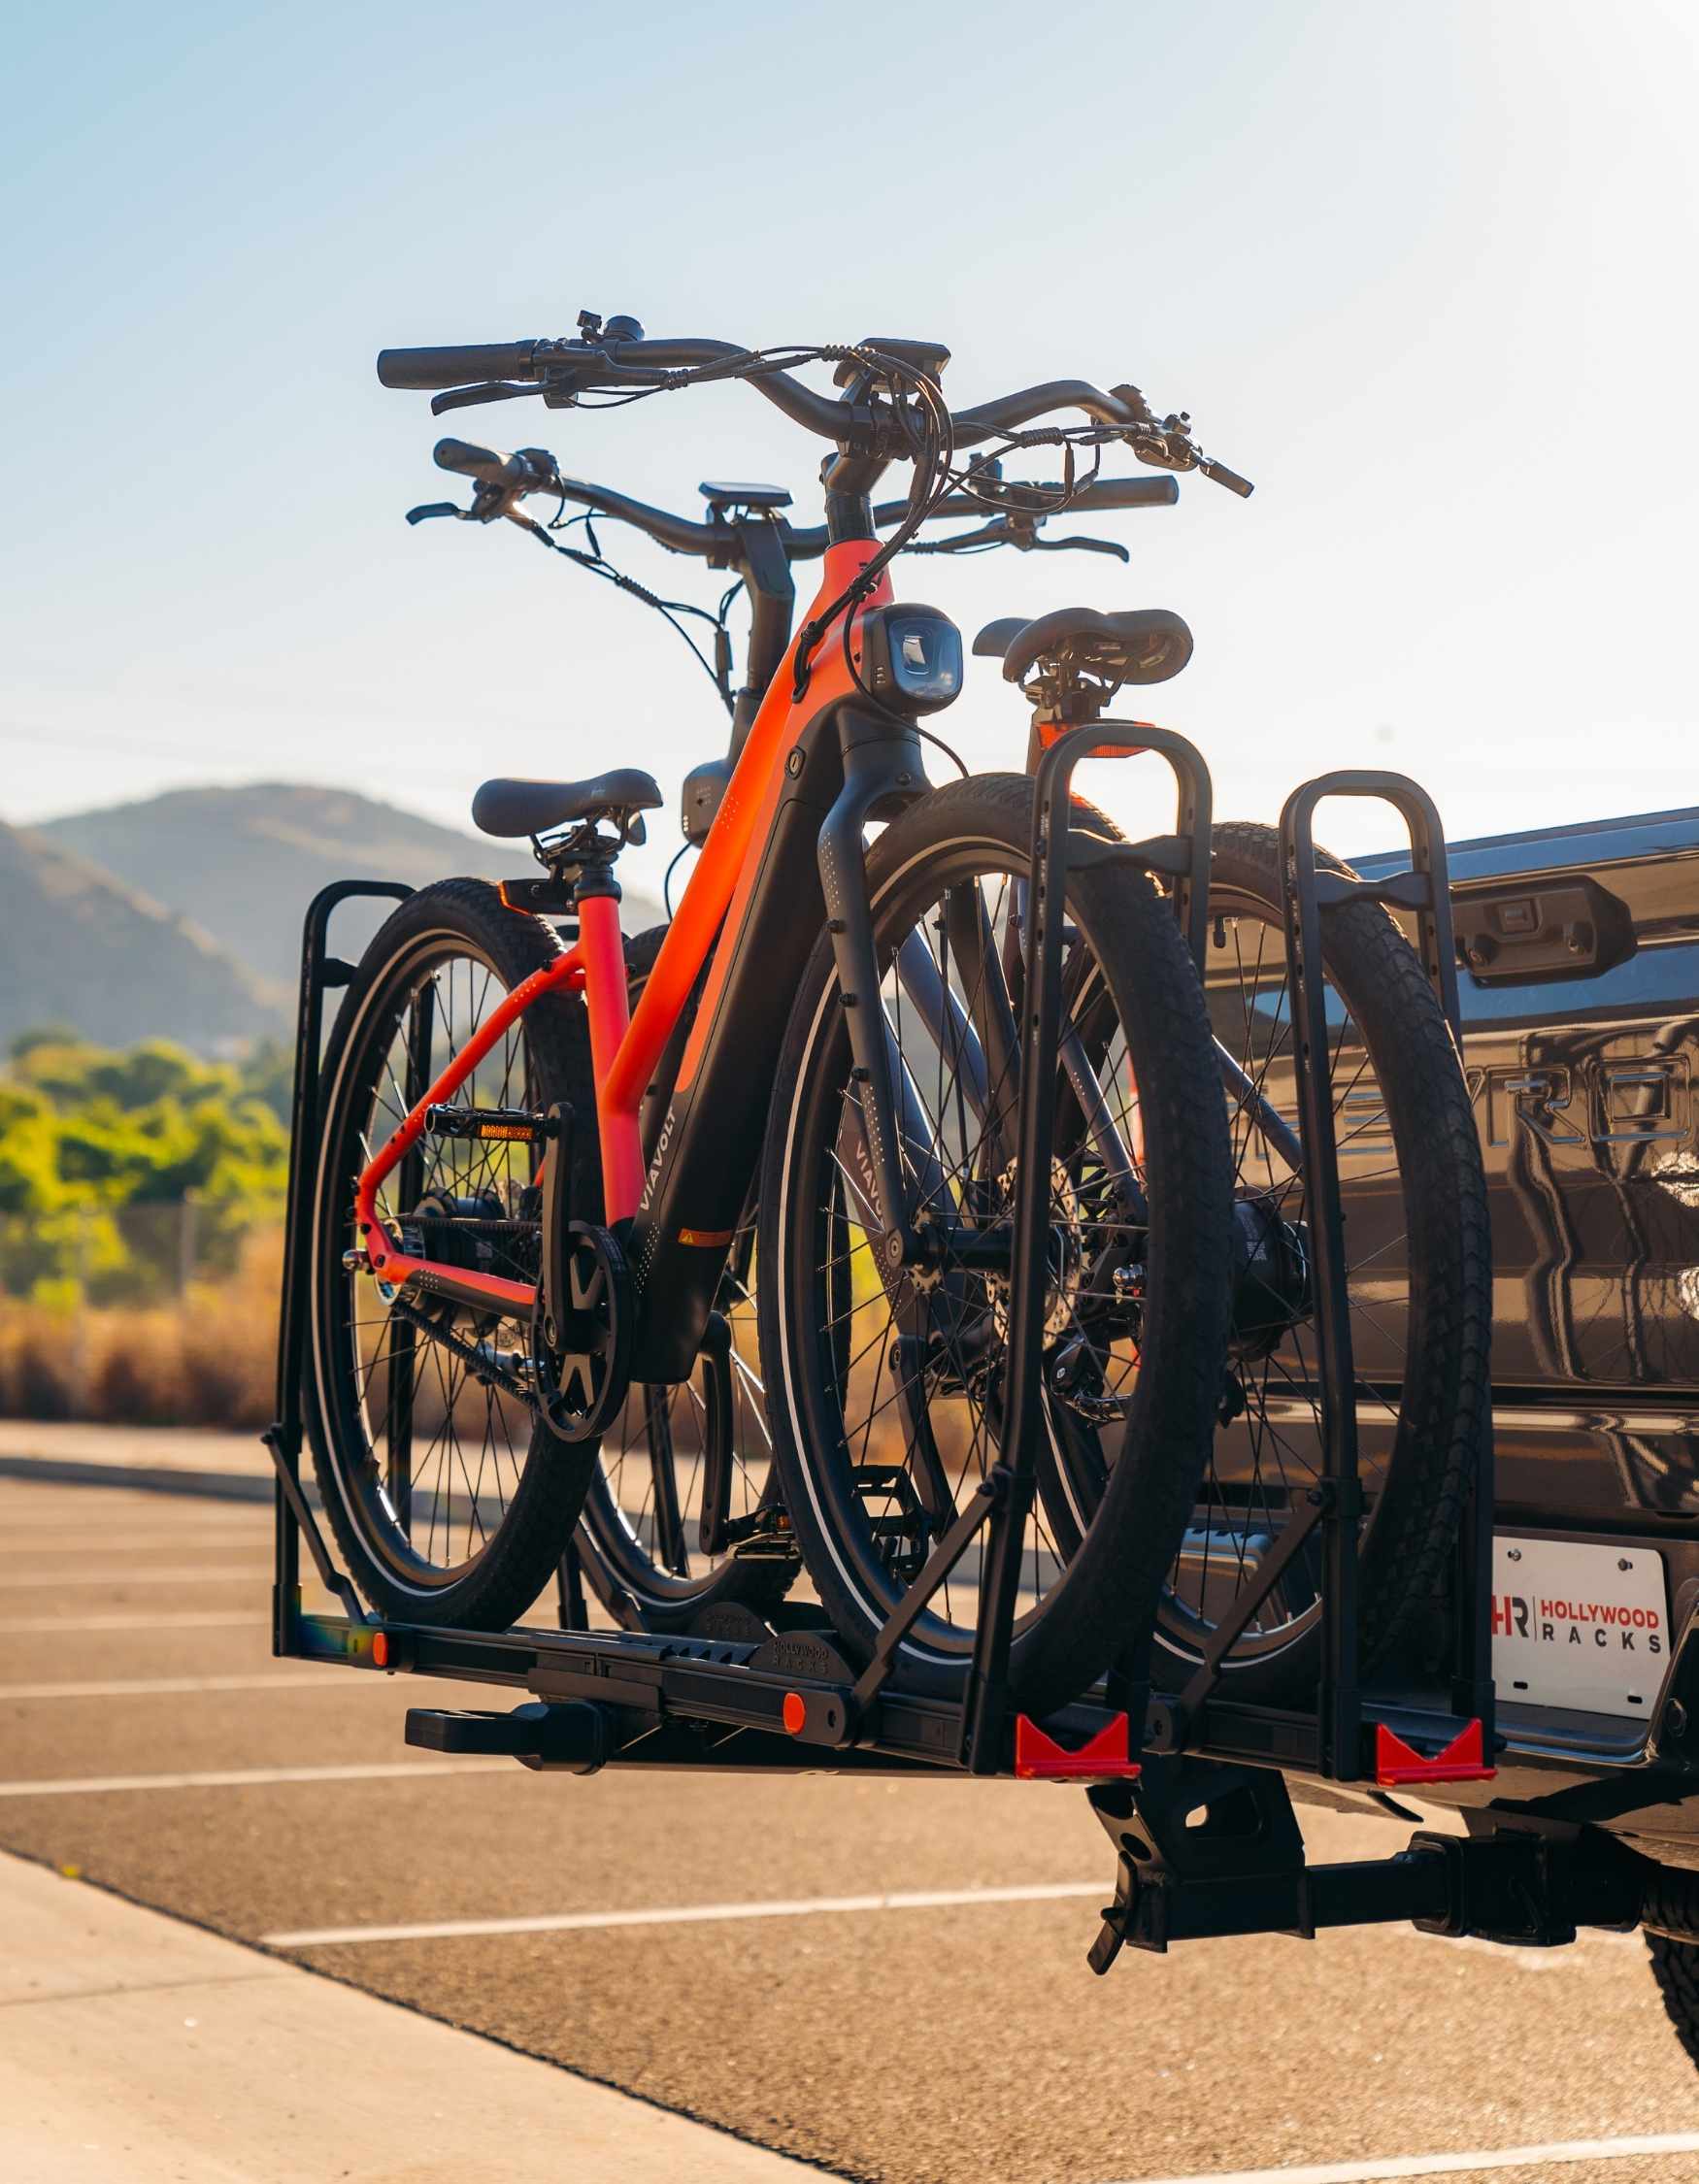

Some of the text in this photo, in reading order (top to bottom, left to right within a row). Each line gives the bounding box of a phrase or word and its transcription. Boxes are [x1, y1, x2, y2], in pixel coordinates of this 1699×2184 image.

[640, 1105, 676, 1210] VIAVOLT
[1541, 1600, 1659, 1629] HOLLYWOOD
[1543, 1623, 1661, 1653] RACKS
